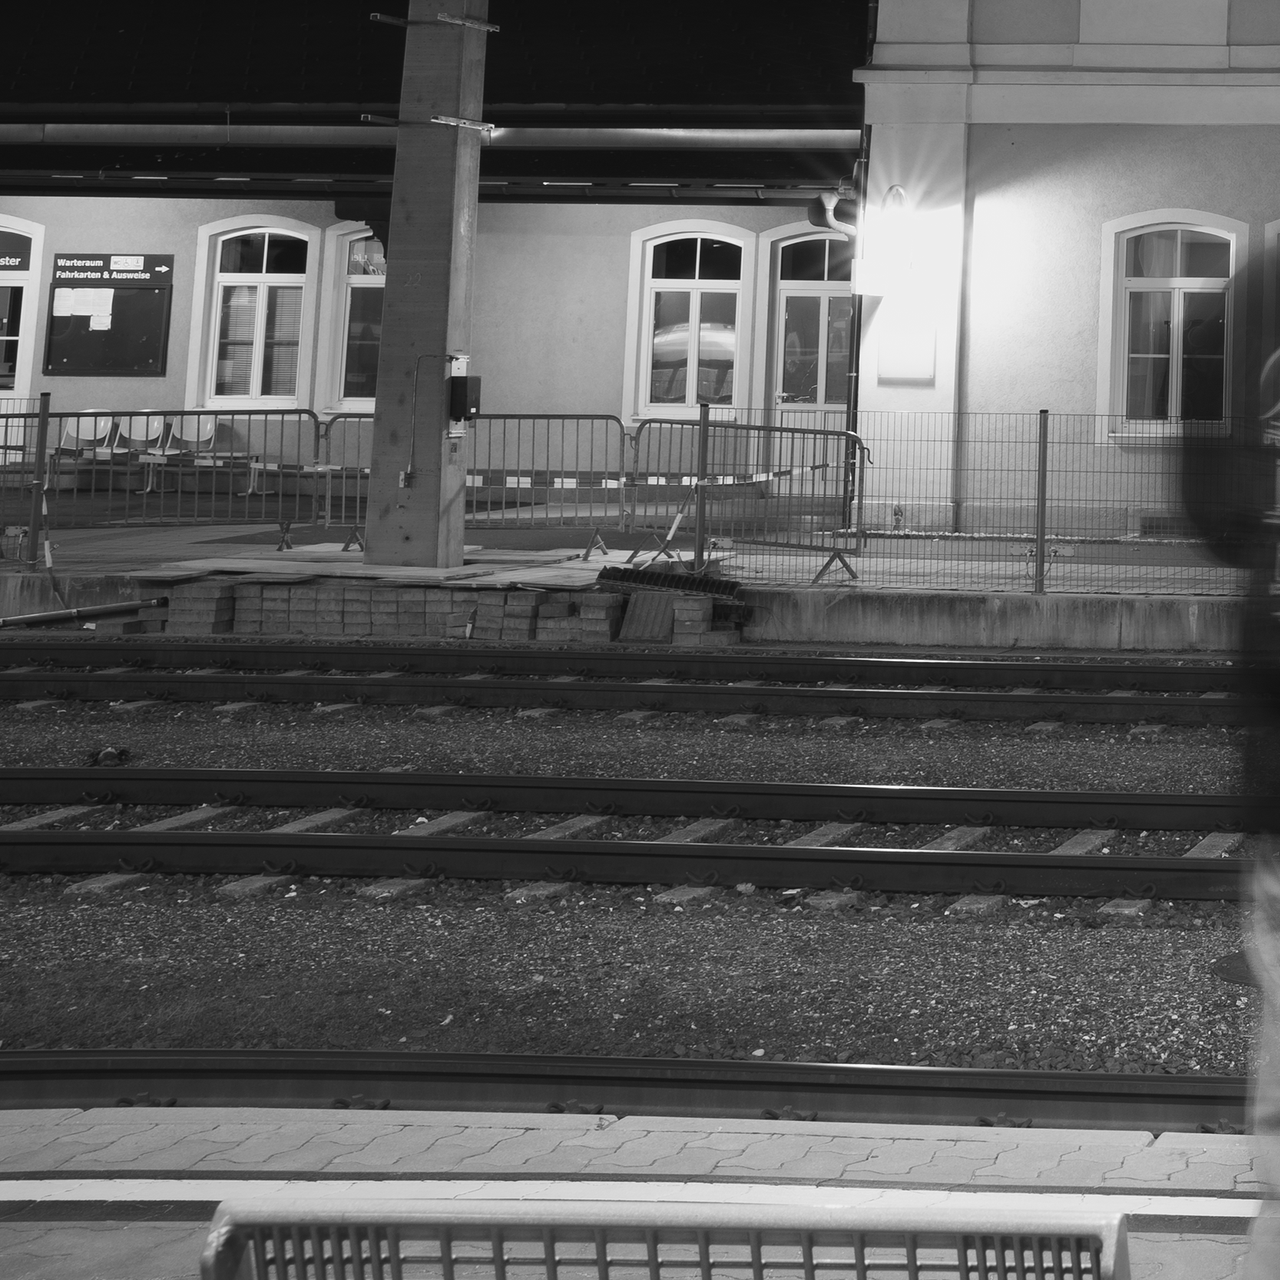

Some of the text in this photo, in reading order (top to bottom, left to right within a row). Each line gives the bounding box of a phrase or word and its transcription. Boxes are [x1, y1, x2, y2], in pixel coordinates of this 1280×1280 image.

[57, 258, 104, 267] Warteraum
[56, 271, 151, 279] Fahrkarten & Ausweise
